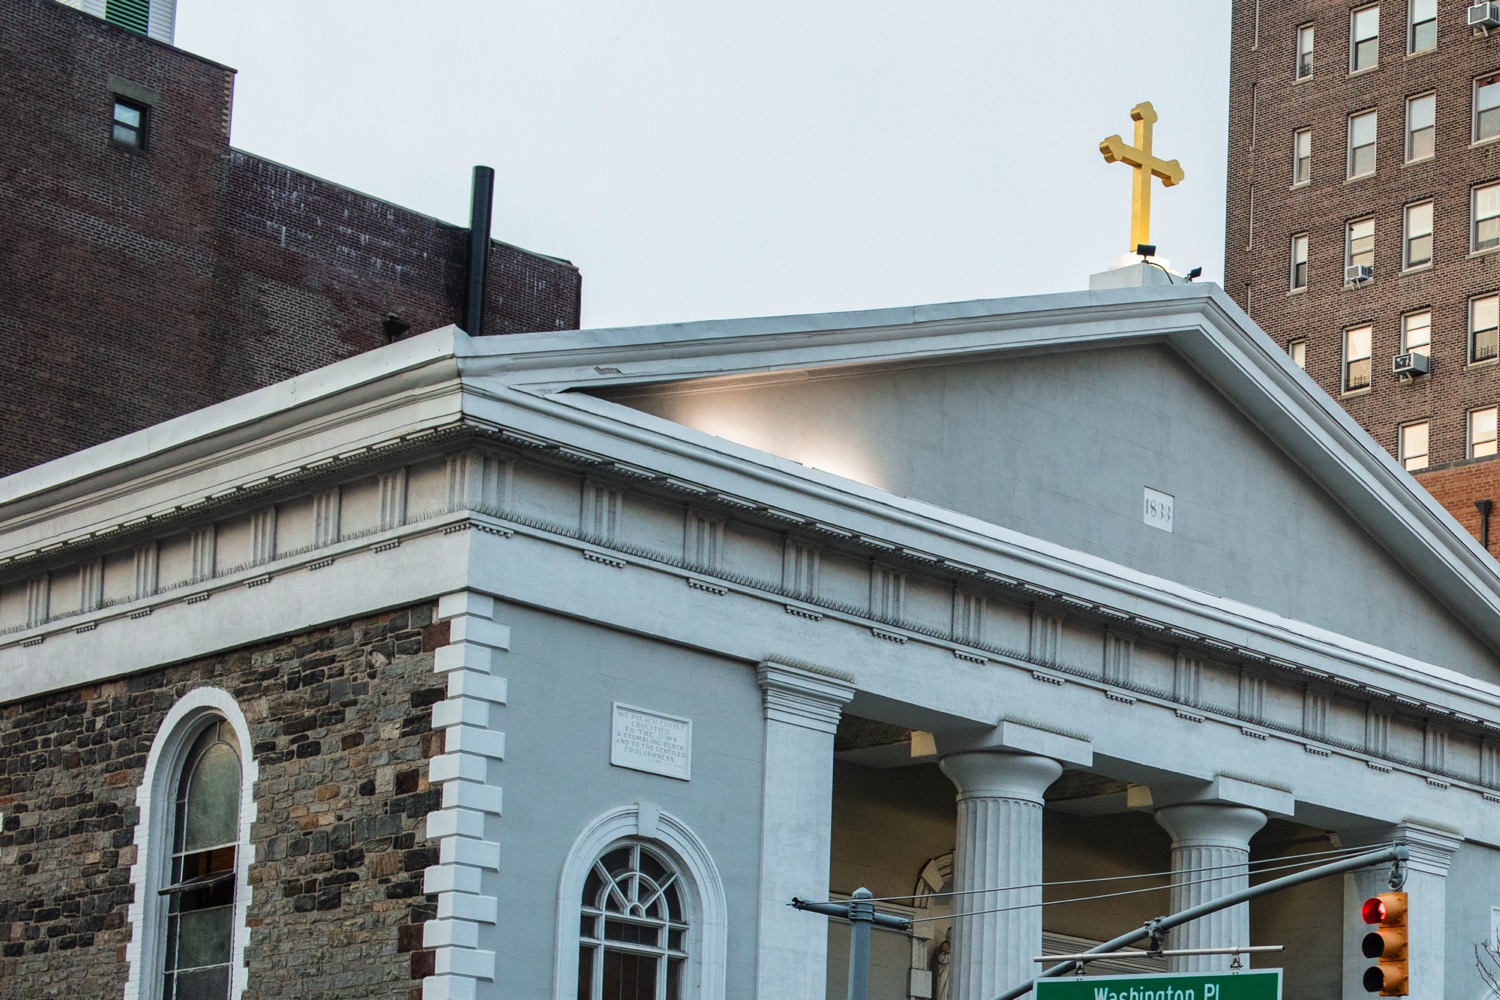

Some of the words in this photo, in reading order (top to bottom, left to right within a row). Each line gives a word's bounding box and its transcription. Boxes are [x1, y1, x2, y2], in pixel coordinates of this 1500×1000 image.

[1145, 498, 1171, 522] 1833
[617, 711, 630, 719] WE
[631, 713, 658, 725] PREACH
[660, 720, 685, 732] CHRIST
[624, 726, 635, 734] TO
[638, 729, 654, 737] THE
[656, 733, 678, 743] JEWS
[641, 743, 654, 751] THE
[663, 741, 685, 752] BLOCK
